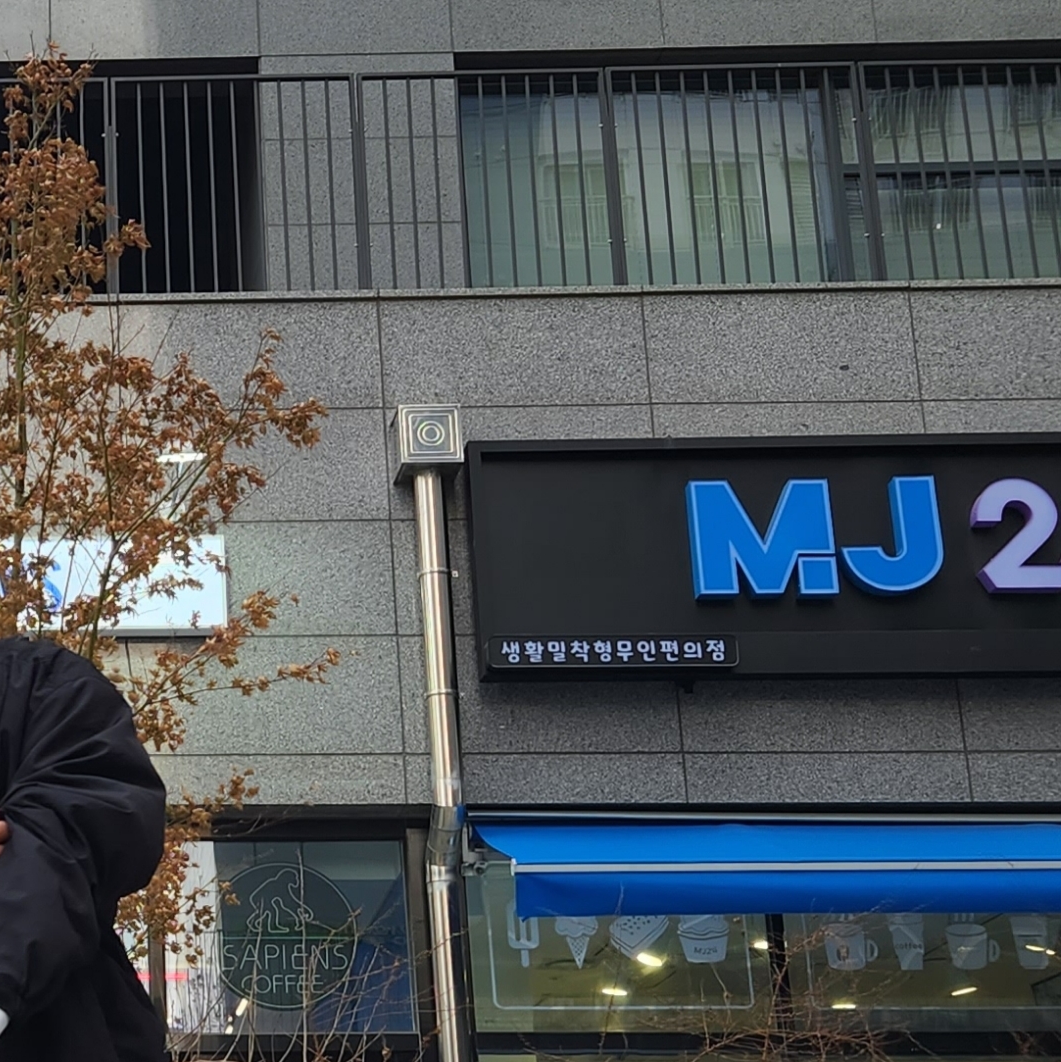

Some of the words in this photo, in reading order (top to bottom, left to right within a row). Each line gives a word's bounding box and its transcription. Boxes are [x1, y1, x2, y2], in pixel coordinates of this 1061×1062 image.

[500, 639, 726, 664] 생활밀착형무인편의점
[222, 943, 349, 970] SAPIENS
[240, 974, 325, 994] COFFEE
